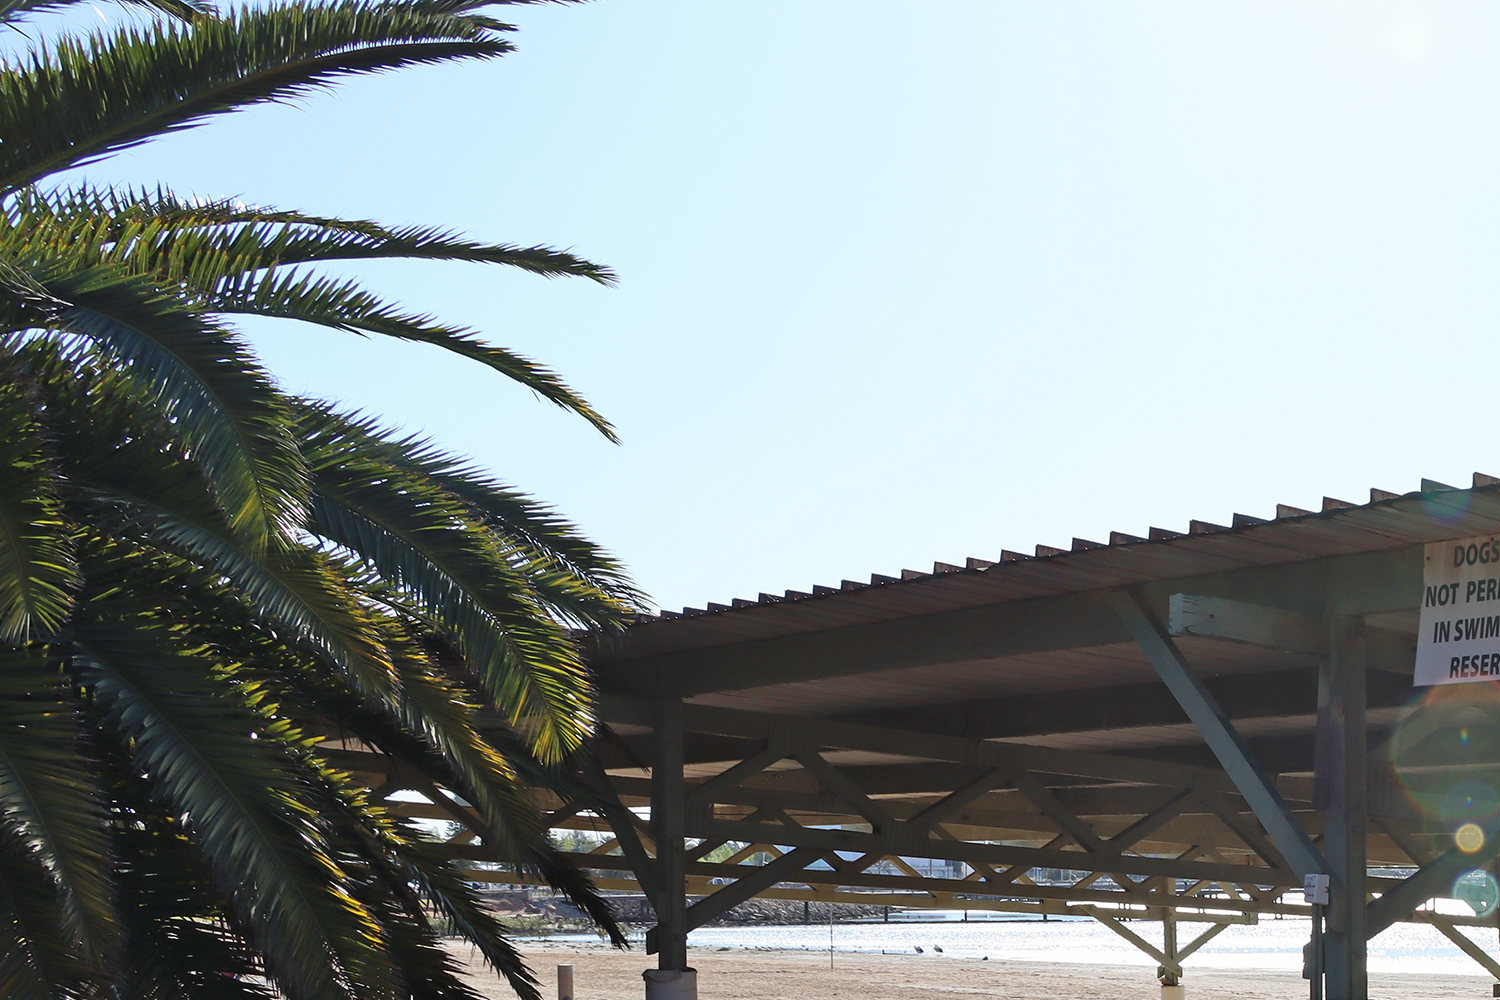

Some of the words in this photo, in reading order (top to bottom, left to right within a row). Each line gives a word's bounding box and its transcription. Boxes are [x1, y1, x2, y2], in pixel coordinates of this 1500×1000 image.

[1453, 540, 1500, 568] DOGS
[1425, 582, 1460, 608] NOT
[1433, 620, 1451, 644] IN
